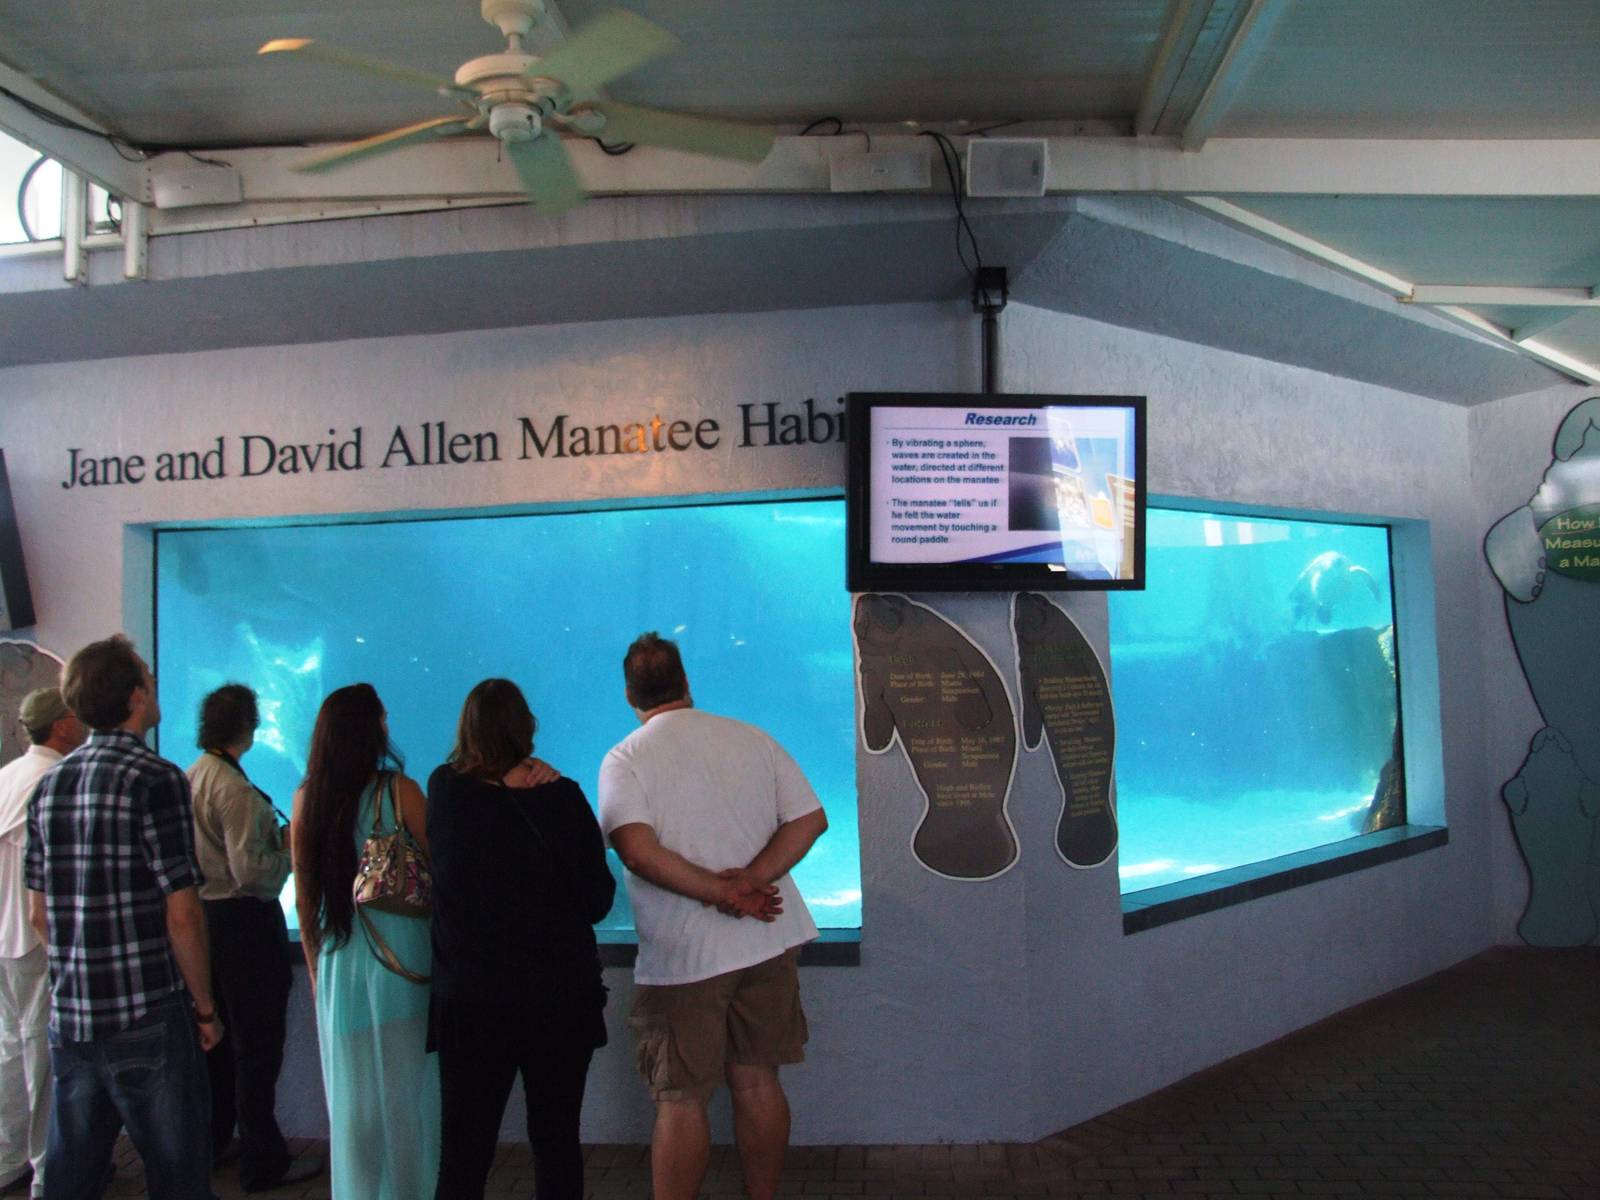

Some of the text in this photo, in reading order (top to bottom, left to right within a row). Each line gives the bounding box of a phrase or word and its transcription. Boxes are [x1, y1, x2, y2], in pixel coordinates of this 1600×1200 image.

[964, 411, 1037, 426] Research
[62, 396, 846, 490] Jane and David Allen Manatee Habi
[892, 438, 904, 448] By
[905, 439, 944, 449] vibrating
[953, 440, 986, 449] sphere,
[892, 452, 919, 460] waves
[937, 451, 969, 460] created
[971, 452, 980, 460] in
[981, 452, 996, 460] the
[920, 463, 956, 472] directed
[957, 464, 966, 472] at
[968, 463, 1004, 472] different
[892, 475, 1000, 484] locations on the manatee
[892, 498, 908, 507] The
[910, 498, 947, 507] manatee
[990, 498, 997, 507] if
[891, 511, 960, 519] he felt the water
[891, 523, 937, 532] movement
[938, 523, 950, 533] by
[951, 523, 989, 533] touching
[1557, 518, 1595, 530] How
[891, 535, 949, 545] round paddle
[1545, 537, 1600, 549] Measu
[1560, 555, 1600, 568] a Ma
